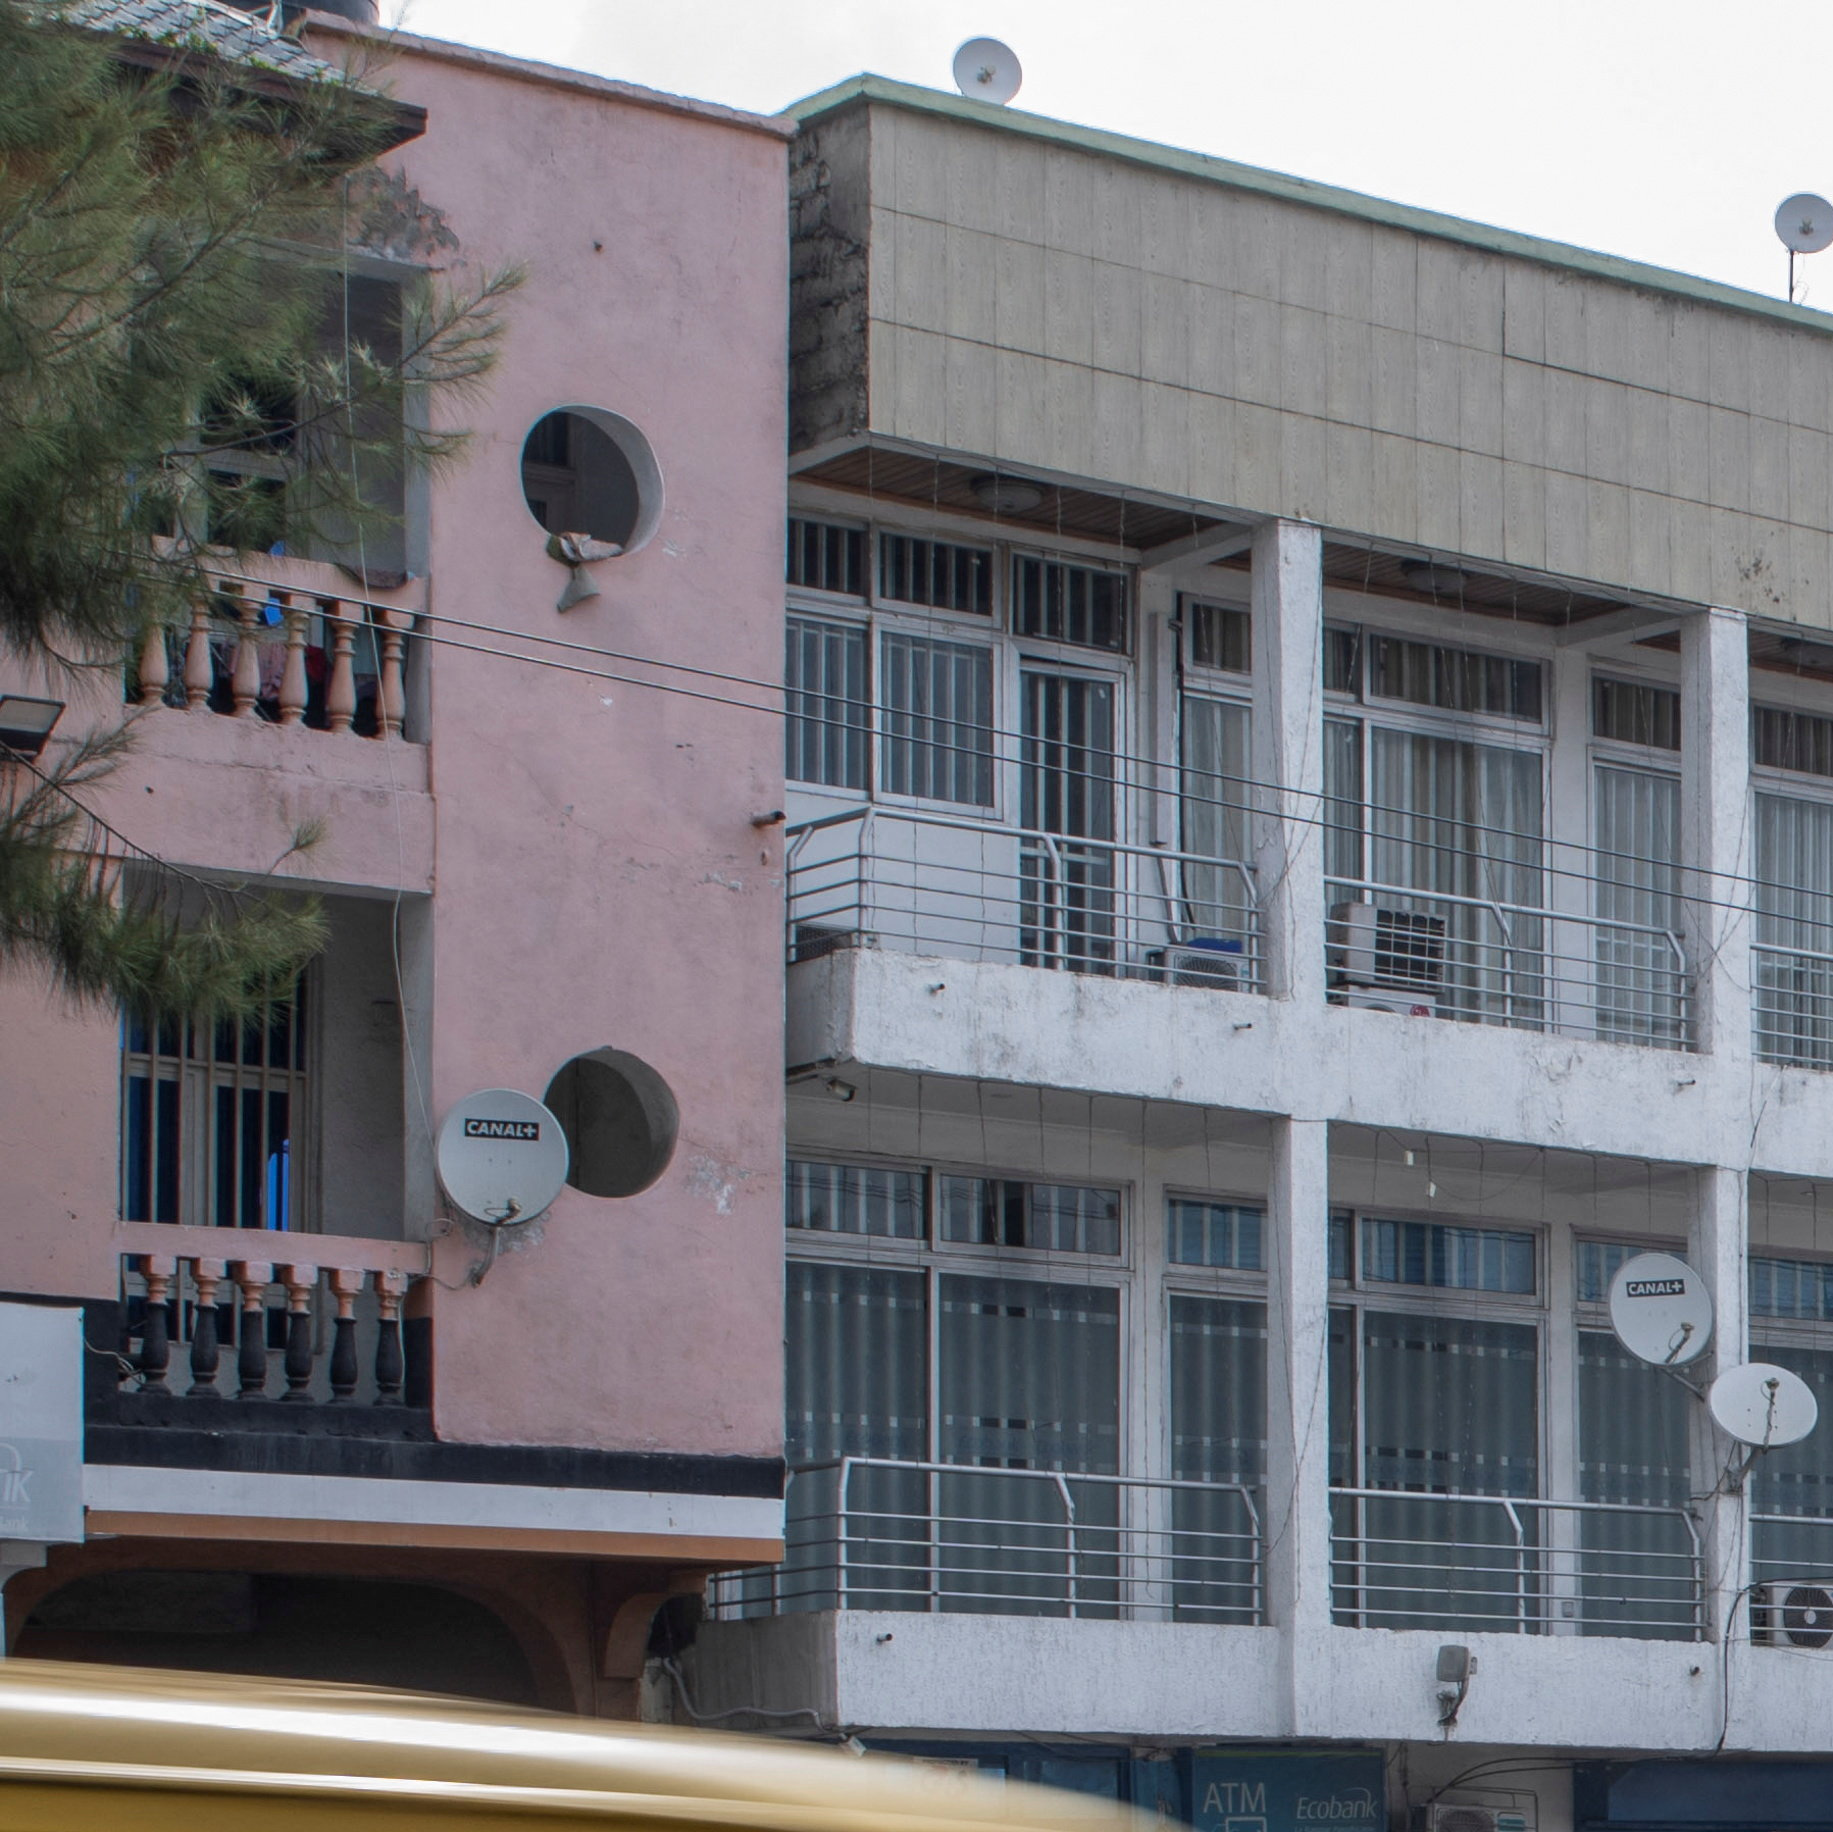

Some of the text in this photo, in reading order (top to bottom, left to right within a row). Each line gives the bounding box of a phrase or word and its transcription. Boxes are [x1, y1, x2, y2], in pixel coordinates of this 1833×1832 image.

[466, 1120, 537, 1138] CANAL+
[1628, 1281, 1682, 1295] CANAL+
[1202, 1782, 1266, 1813] ATM
[1296, 1787, 1378, 1819] Ecobank
